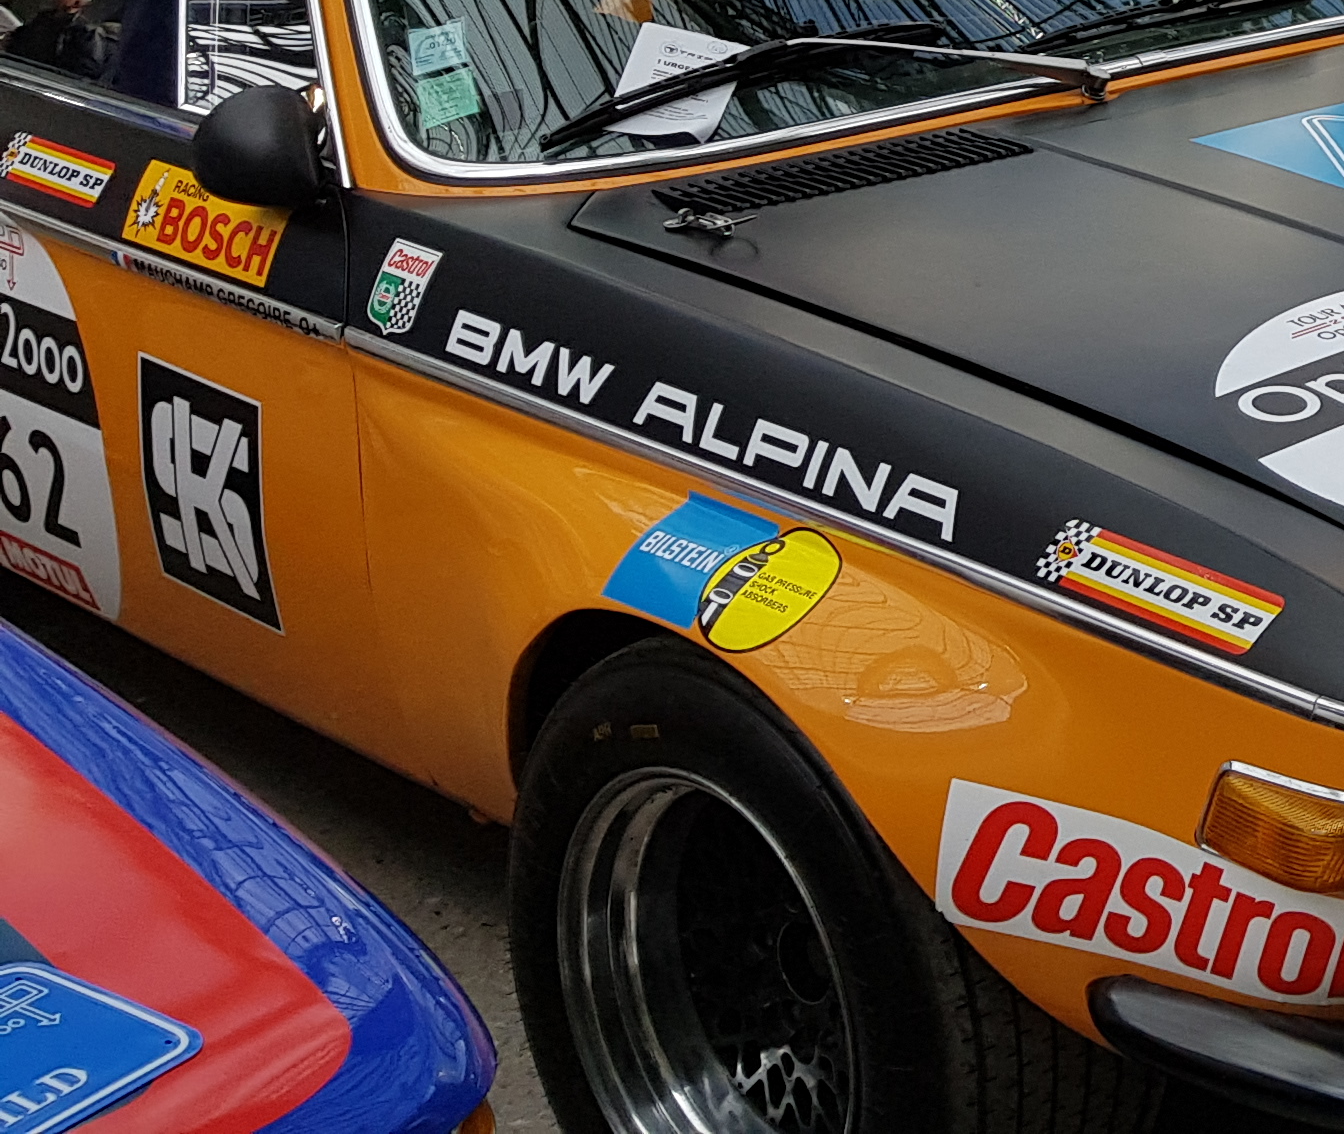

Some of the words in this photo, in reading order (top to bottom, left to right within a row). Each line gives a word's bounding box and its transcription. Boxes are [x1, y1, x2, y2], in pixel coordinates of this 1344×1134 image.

[16, 151, 82, 182] DUNLOP
[77, 173, 105, 192] SP
[173, 178, 210, 202] RACING
[156, 197, 278, 277] BOSCH
[132, 257, 214, 298] MAUCHAMP
[387, 248, 438, 278] Castrol
[1286, 307, 1341, 328] TOUR
[444, 309, 616, 405] BMW
[632, 380, 959, 543] ALPINA
[639, 530, 726, 574] BILSTEIN
[4, 538, 94, 608] MOTUL
[748, 580, 778, 597] SHOCK
[757, 571, 777, 585] GAS
[776, 577, 817, 600] PRESSURE
[1080, 550, 1213, 611] DUNLOP
[1209, 602, 1265, 631] SP
[740, 589, 789, 614] ABSORBERS
